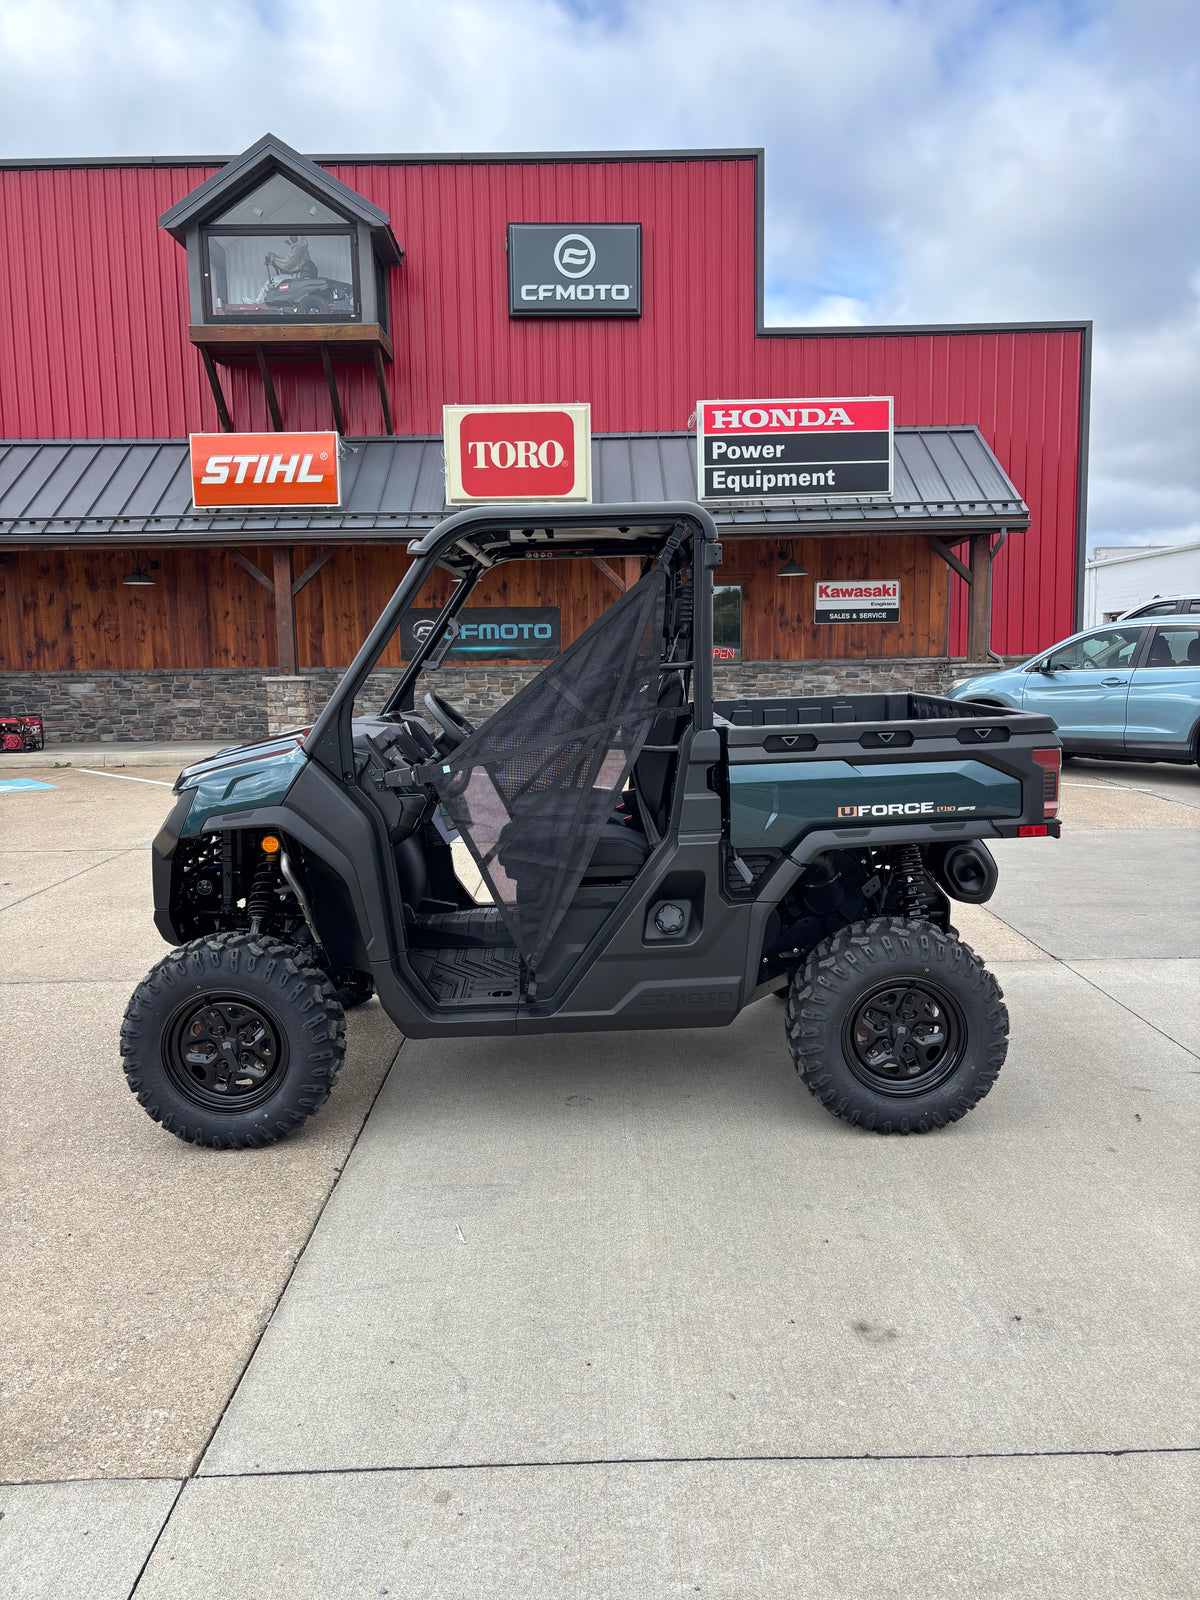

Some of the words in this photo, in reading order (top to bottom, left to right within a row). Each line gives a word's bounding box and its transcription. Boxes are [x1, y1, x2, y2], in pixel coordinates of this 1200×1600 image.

[521, 284, 630, 300] CFMOTO
[712, 407, 855, 429] HONDA
[468, 440, 565, 469] TORO
[712, 441, 785, 460] Power
[200, 454, 324, 484] STIHL
[712, 469, 836, 492] Equipment
[818, 584, 897, 598] Kawasaki
[712, 648, 735, 660] PEN
[837, 801, 935, 818] UFORCE
[640, 991, 733, 1009] CFMOTO
